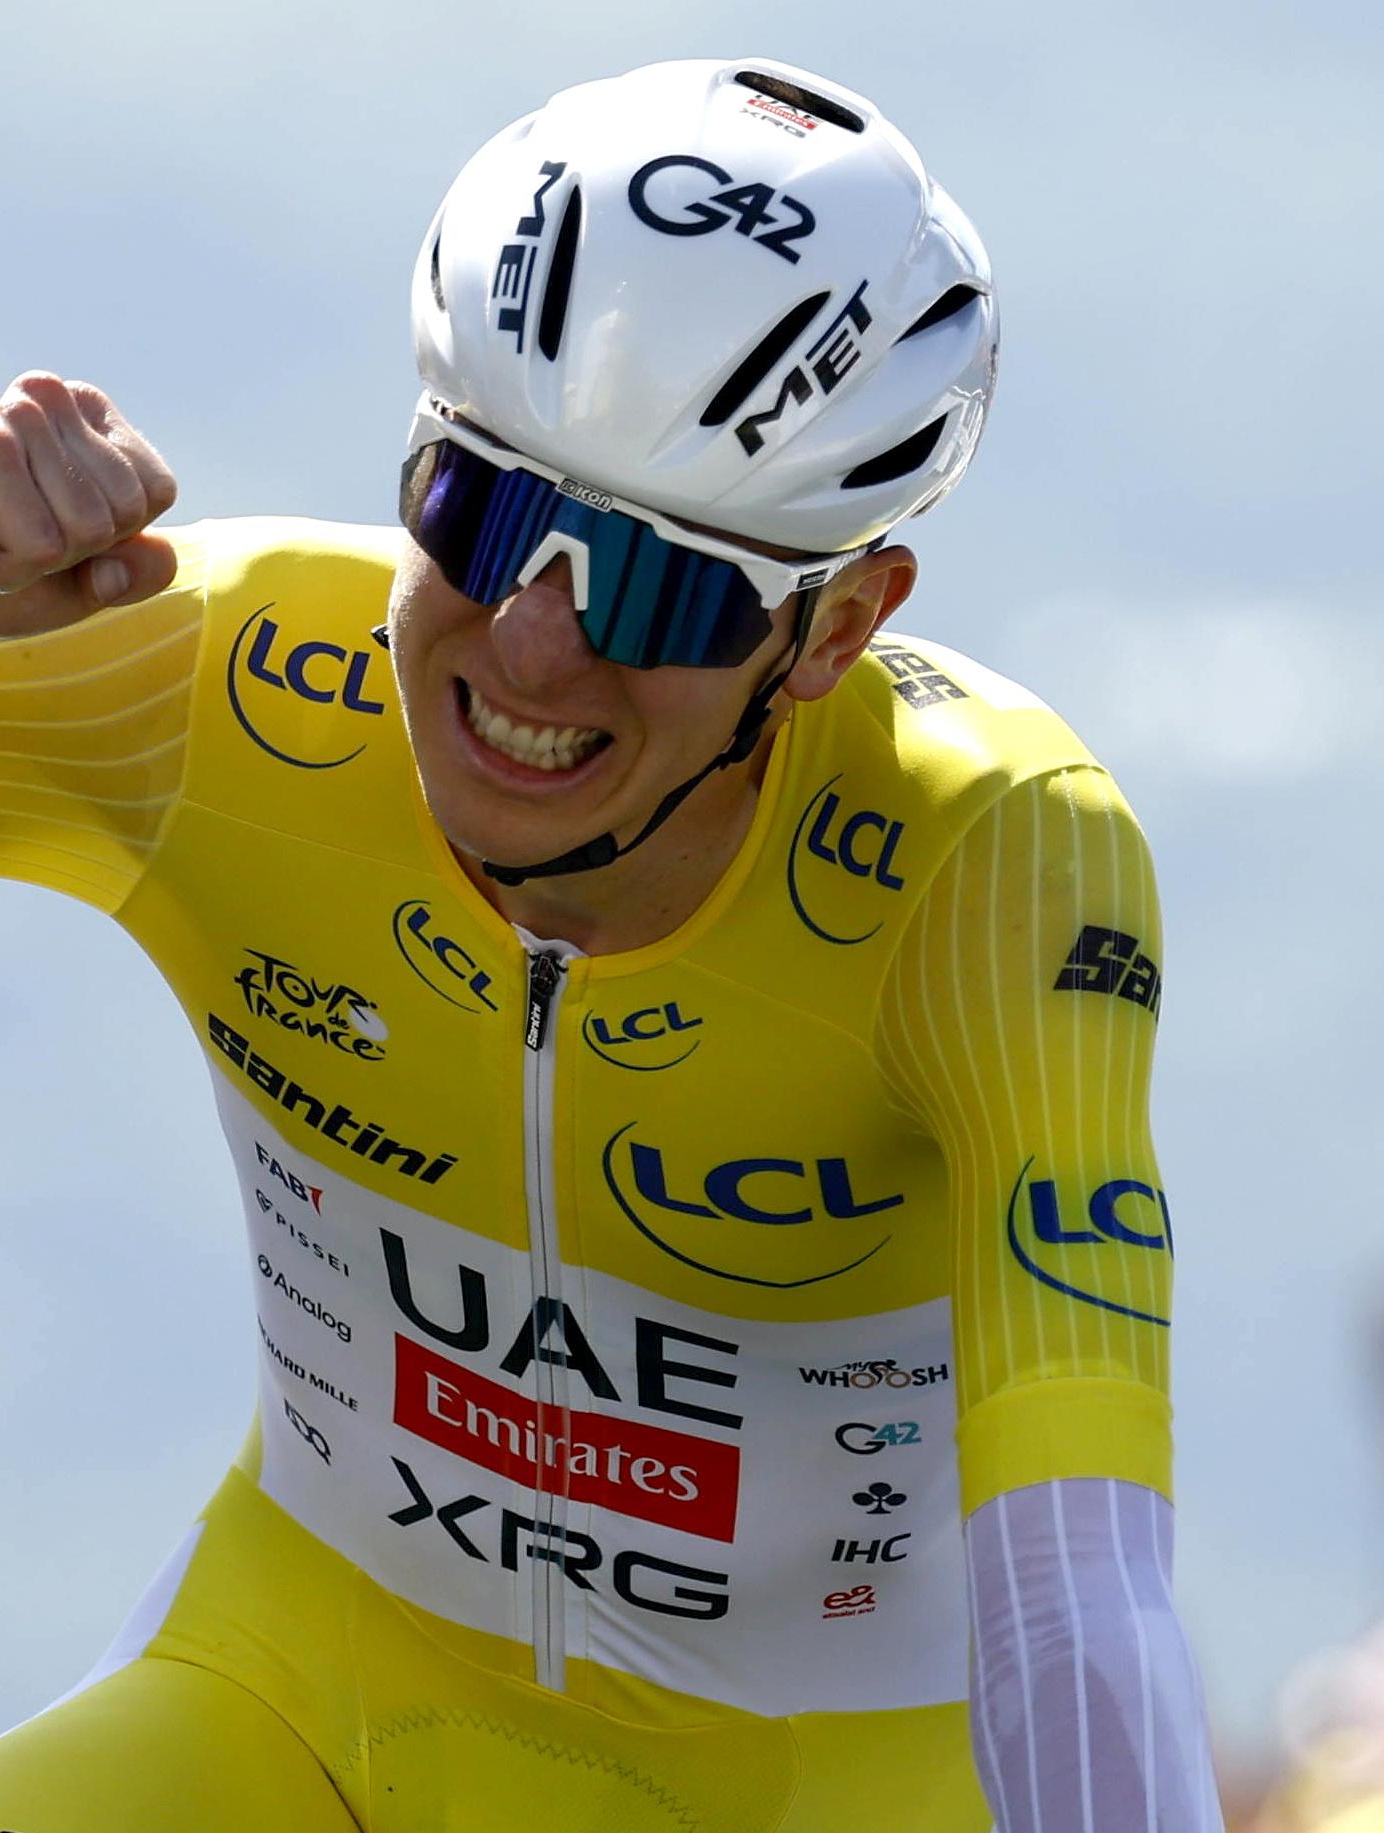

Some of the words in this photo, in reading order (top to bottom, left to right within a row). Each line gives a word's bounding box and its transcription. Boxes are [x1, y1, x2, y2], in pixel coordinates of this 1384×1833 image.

[628, 155, 816, 265] G42
[492, 160, 568, 354] MET
[734, 279, 873, 456] MET
[247, 618, 386, 714] LCL
[807, 793, 905, 891] LCL
[405, 906, 499, 1011] LCL
[526, 1001, 542, 1048] Santini
[589, 1002, 704, 1046] LCL
[208, 1013, 458, 1184] Santini
[629, 1141, 905, 1227] LCL
[1029, 1179, 1174, 1261] LC
[276, 1211, 349, 1277] PISSEI
[273, 1272, 352, 1343] Analog
[379, 1227, 743, 1431] UAE
[309, 1372, 358, 1412] MILLE
[799, 1364, 948, 1389] WHOOSH
[425, 1369, 699, 1503] Emirates
[835, 1422, 921, 1455] G42
[388, 1455, 729, 1621] XRG
[831, 1533, 911, 1564] IHC
